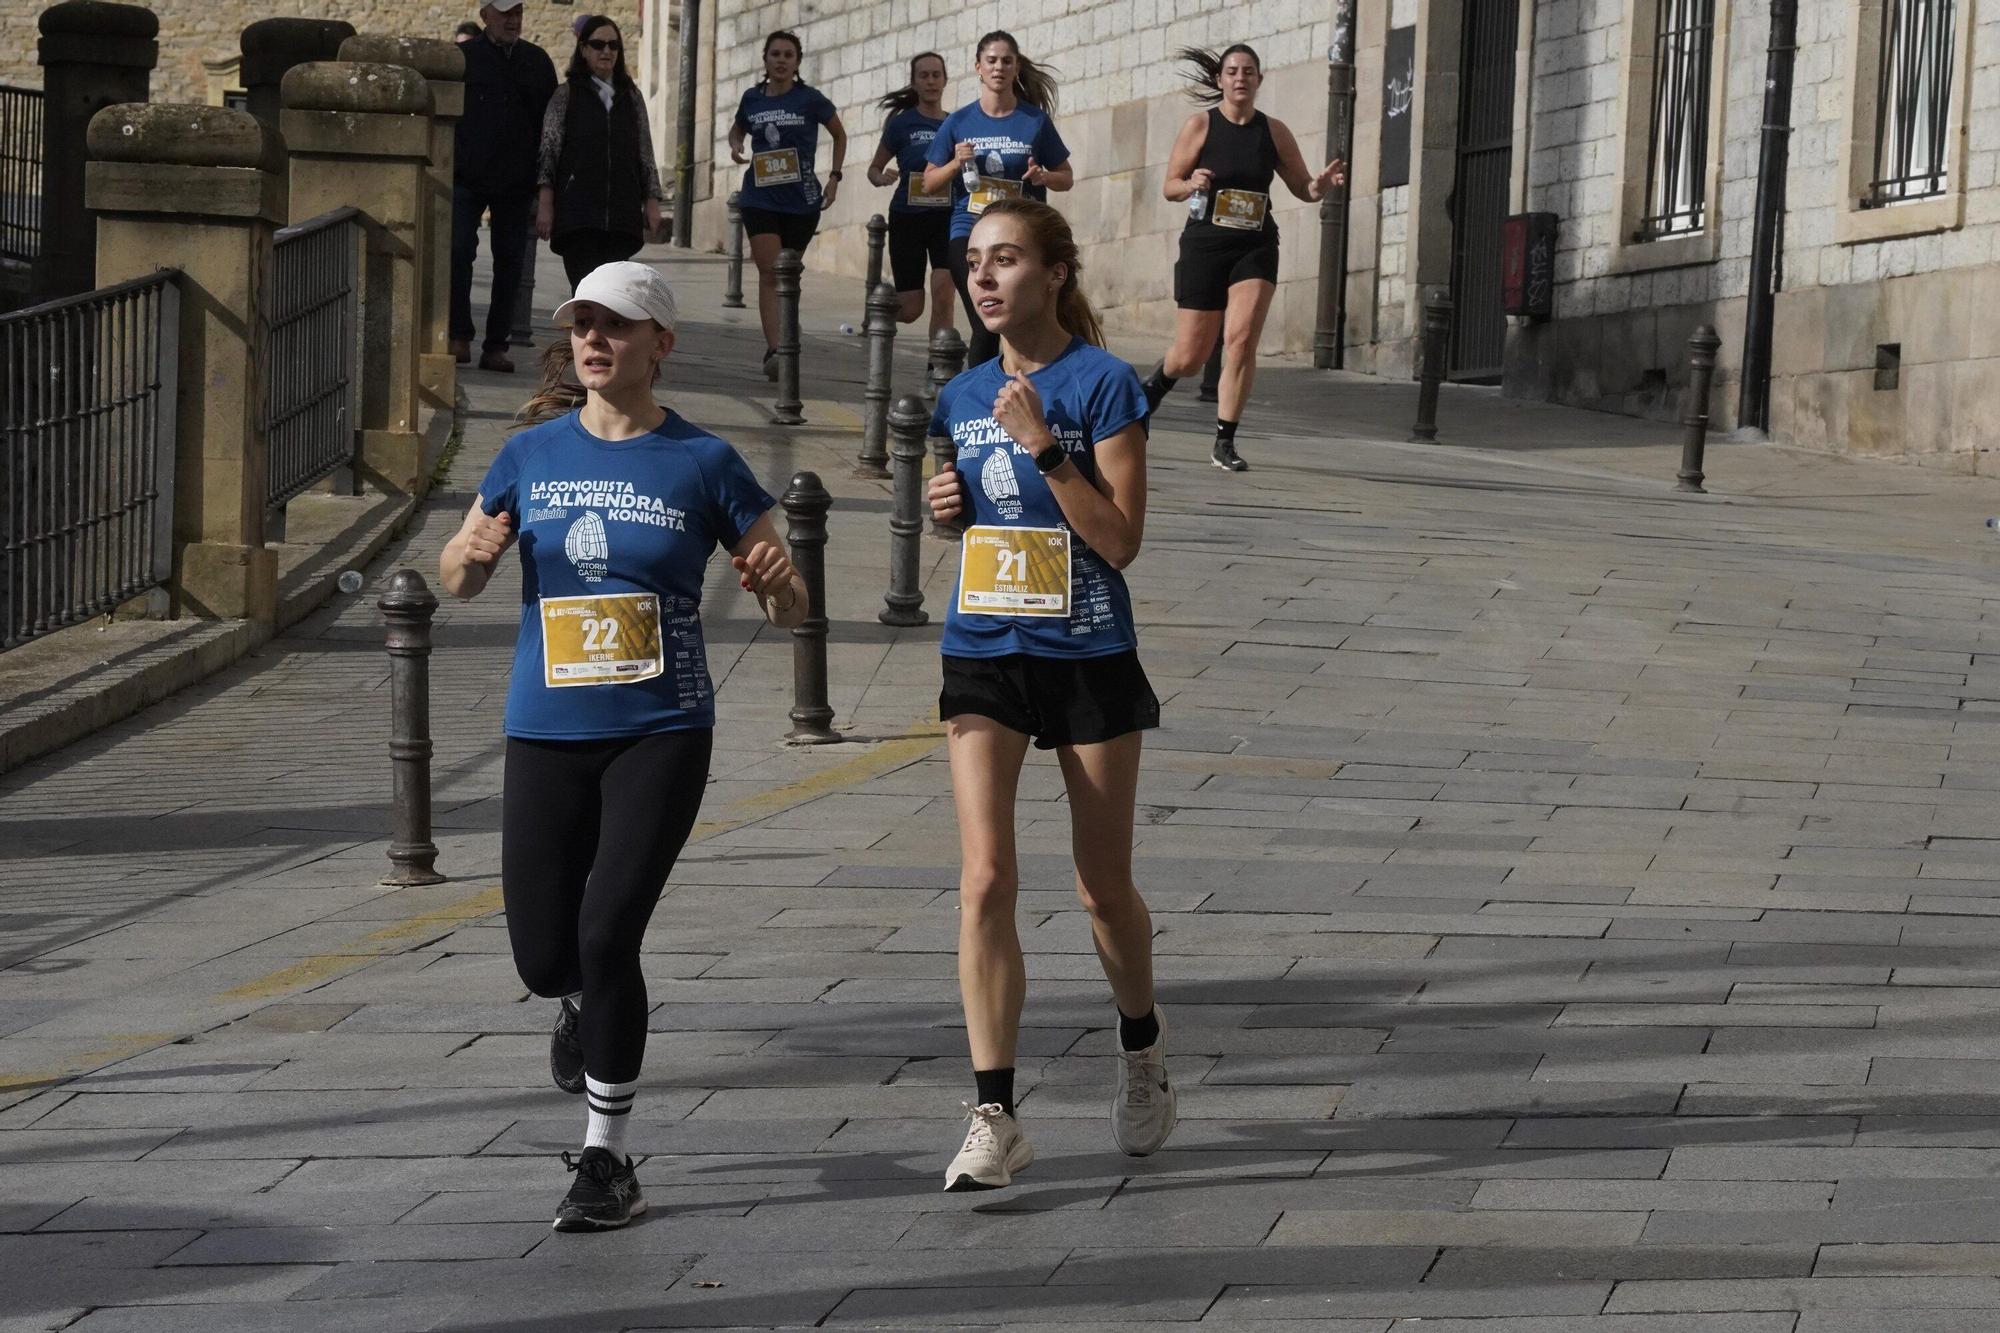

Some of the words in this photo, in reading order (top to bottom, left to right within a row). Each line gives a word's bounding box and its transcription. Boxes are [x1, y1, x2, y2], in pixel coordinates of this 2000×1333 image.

[974, 141, 1025, 150] ALMENDRA
[954, 422, 965, 434] LA
[964, 423, 1063, 447] ALMEA
[1064, 430, 1083, 439] REN
[531, 482, 546, 492] LA
[548, 480, 635, 493] CONQUISTA
[530, 492, 541, 500] DE
[541, 491, 551, 500] LA
[548, 492, 666, 514] ALMENDRA
[666, 507, 686, 519] REN
[607, 509, 686, 532] KONKISTA
[1048, 538, 1062, 546] 10K
[577, 562, 608, 571] VITORIA
[996, 549, 1027, 582] 21
[577, 569, 608, 577] GASTEIZ
[994, 584, 1028, 593] ESTIBALIZ
[637, 601, 652, 611] 10K
[582, 618, 619, 651] 22
[588, 654, 615, 662] IKERNE
